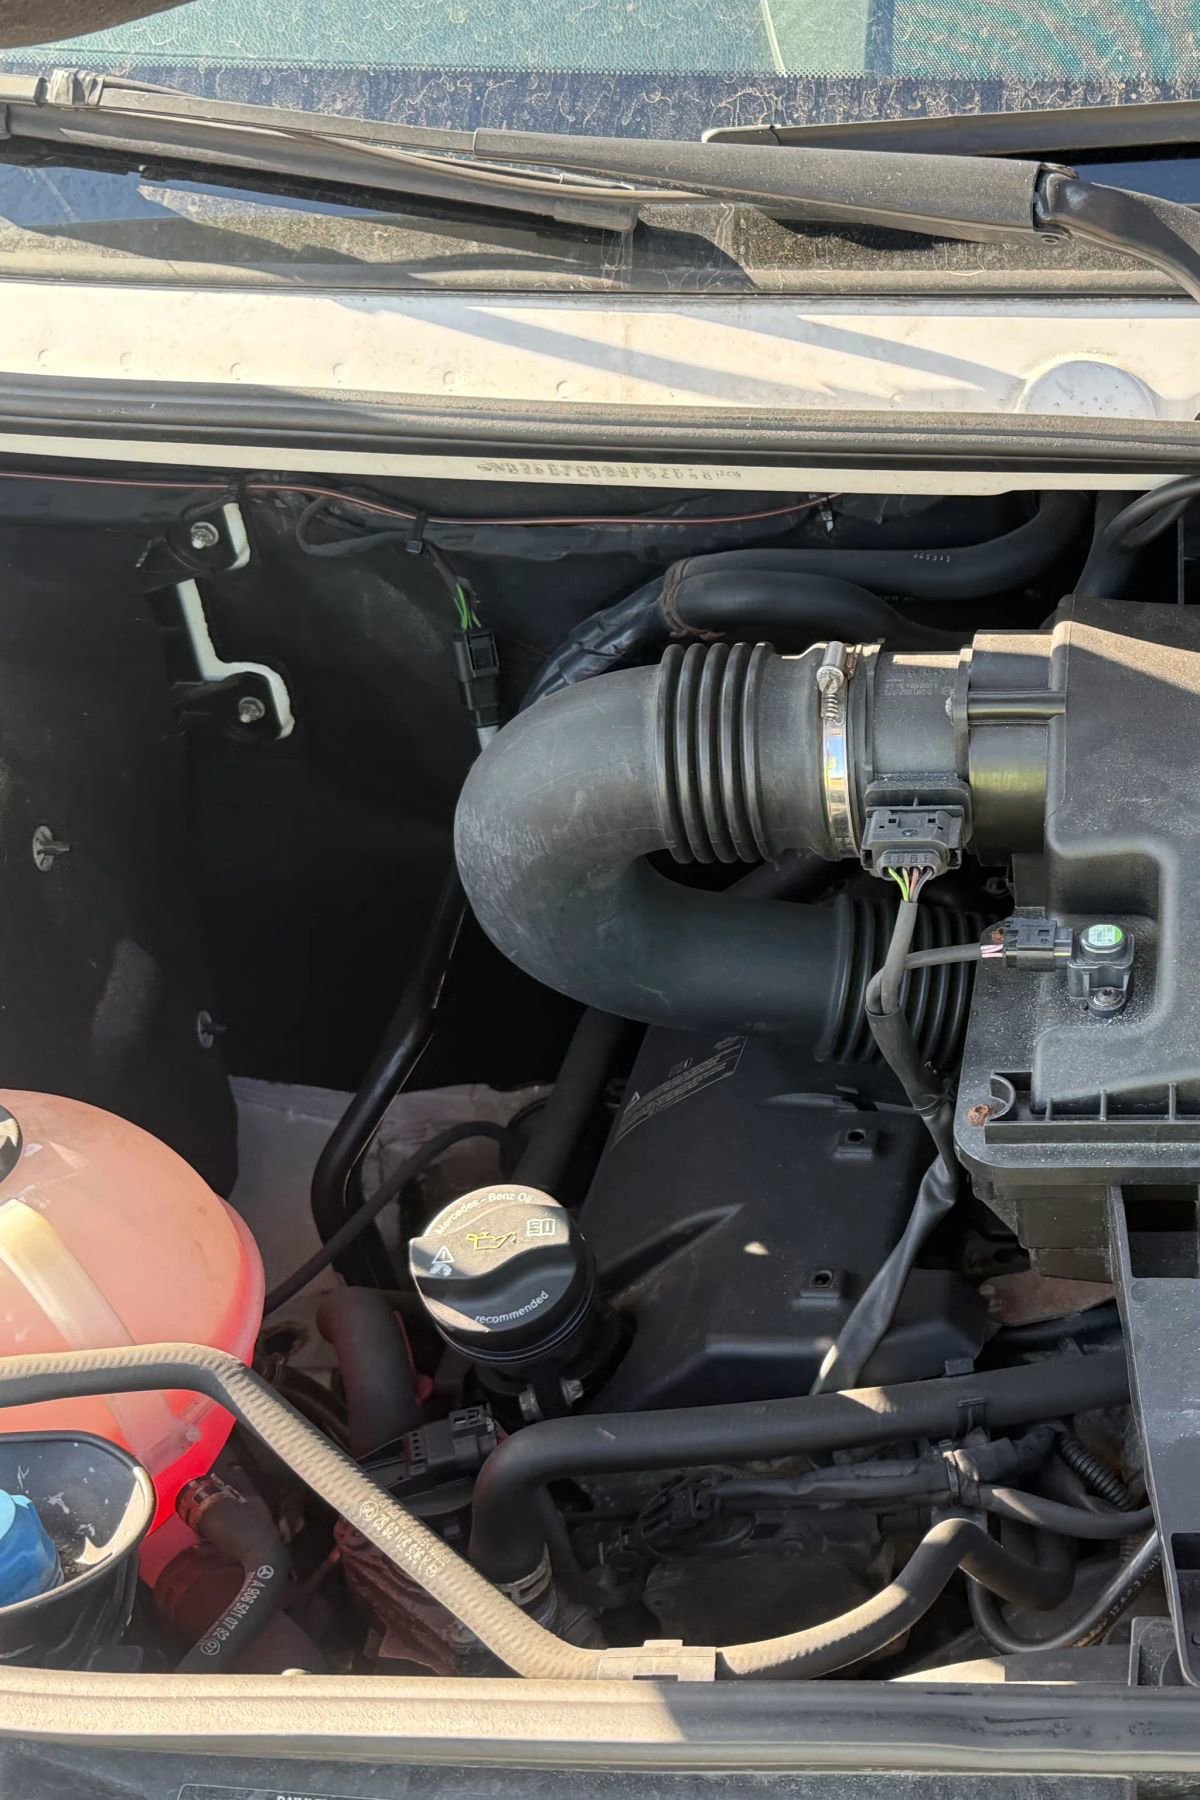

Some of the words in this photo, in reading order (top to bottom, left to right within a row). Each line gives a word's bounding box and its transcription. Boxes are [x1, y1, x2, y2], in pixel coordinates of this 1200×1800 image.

[475, 1290, 549, 1324] recommended
[251, 1580, 266, 1588] A
[240, 1588, 261, 1604] 906
[230, 1602, 250, 1619] 501
[223, 1616, 239, 1631] 07
[213, 1627, 230, 1641] 82
